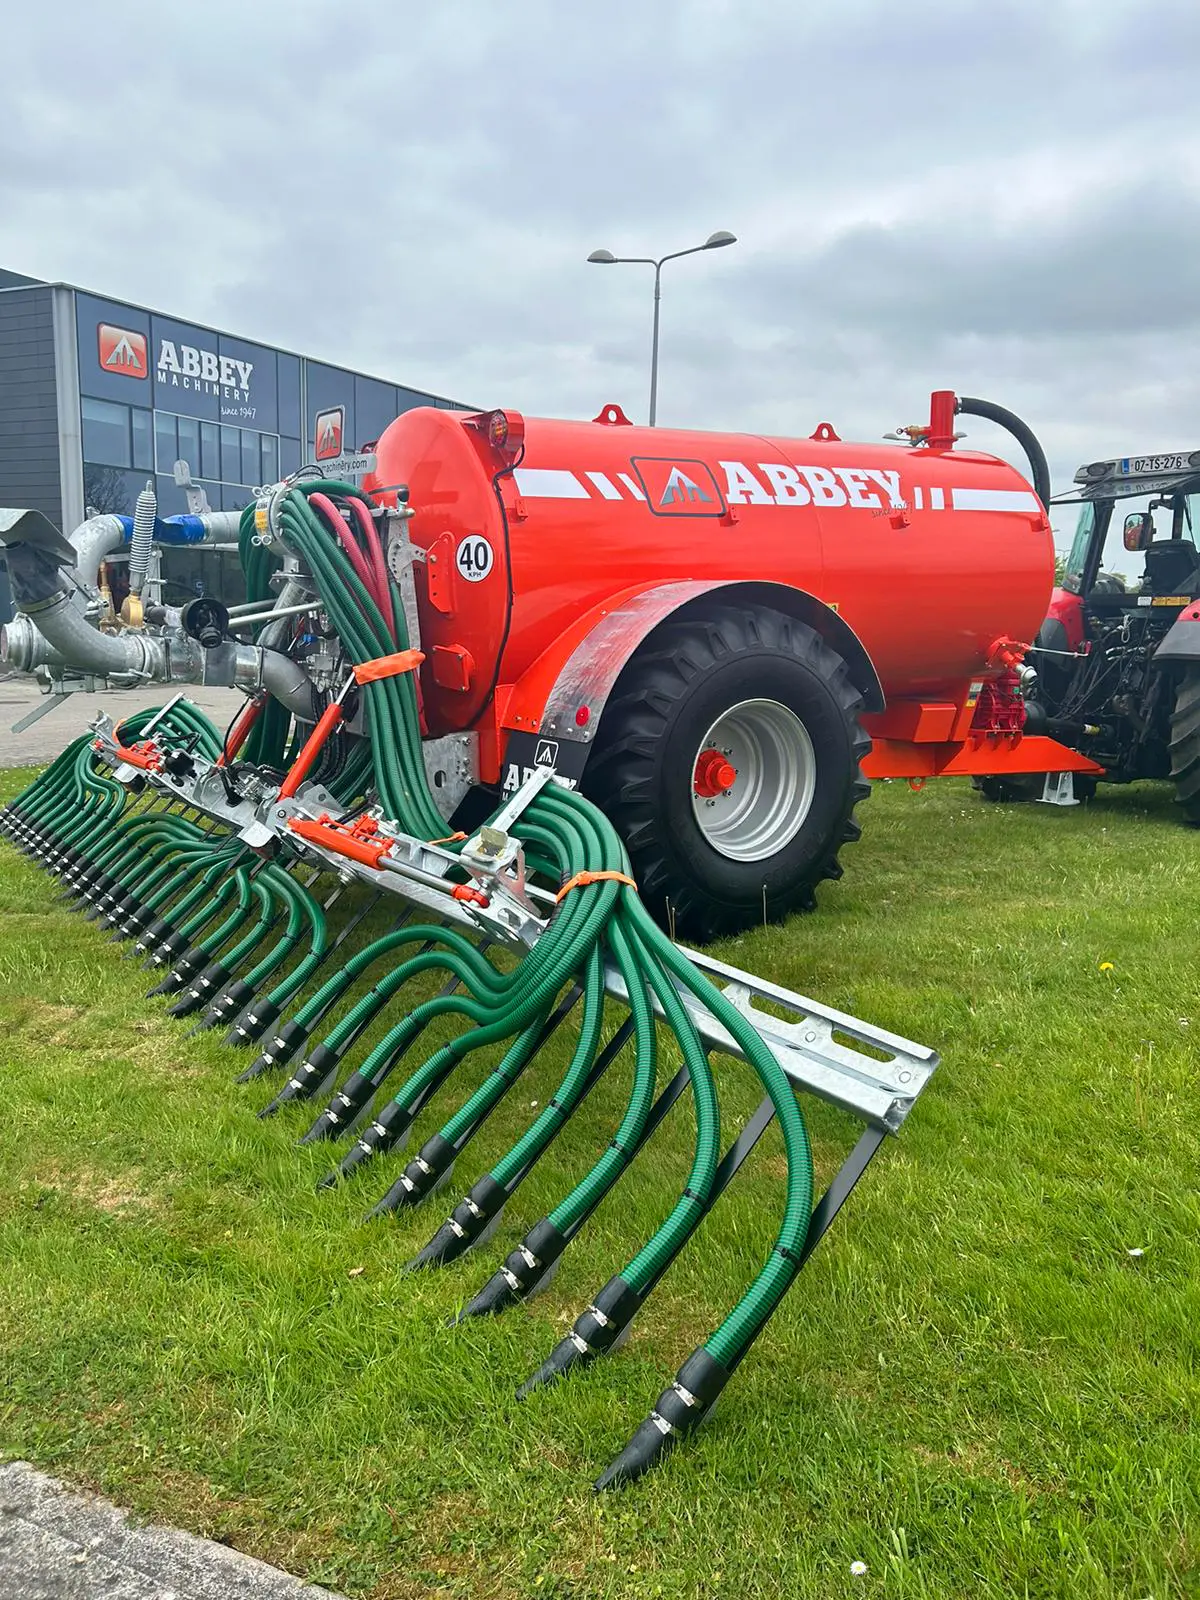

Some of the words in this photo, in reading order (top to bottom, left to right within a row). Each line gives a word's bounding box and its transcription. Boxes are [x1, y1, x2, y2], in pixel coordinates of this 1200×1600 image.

[157, 339, 253, 391] ABBEY
[157, 370, 250, 402] MACHINERY
[221, 406, 239, 416] since
[239, 407, 257, 419] 1947
[1134, 456, 1182, 472] 07-TS-276
[718, 461, 906, 509] ABBEY
[459, 541, 489, 571] 40
